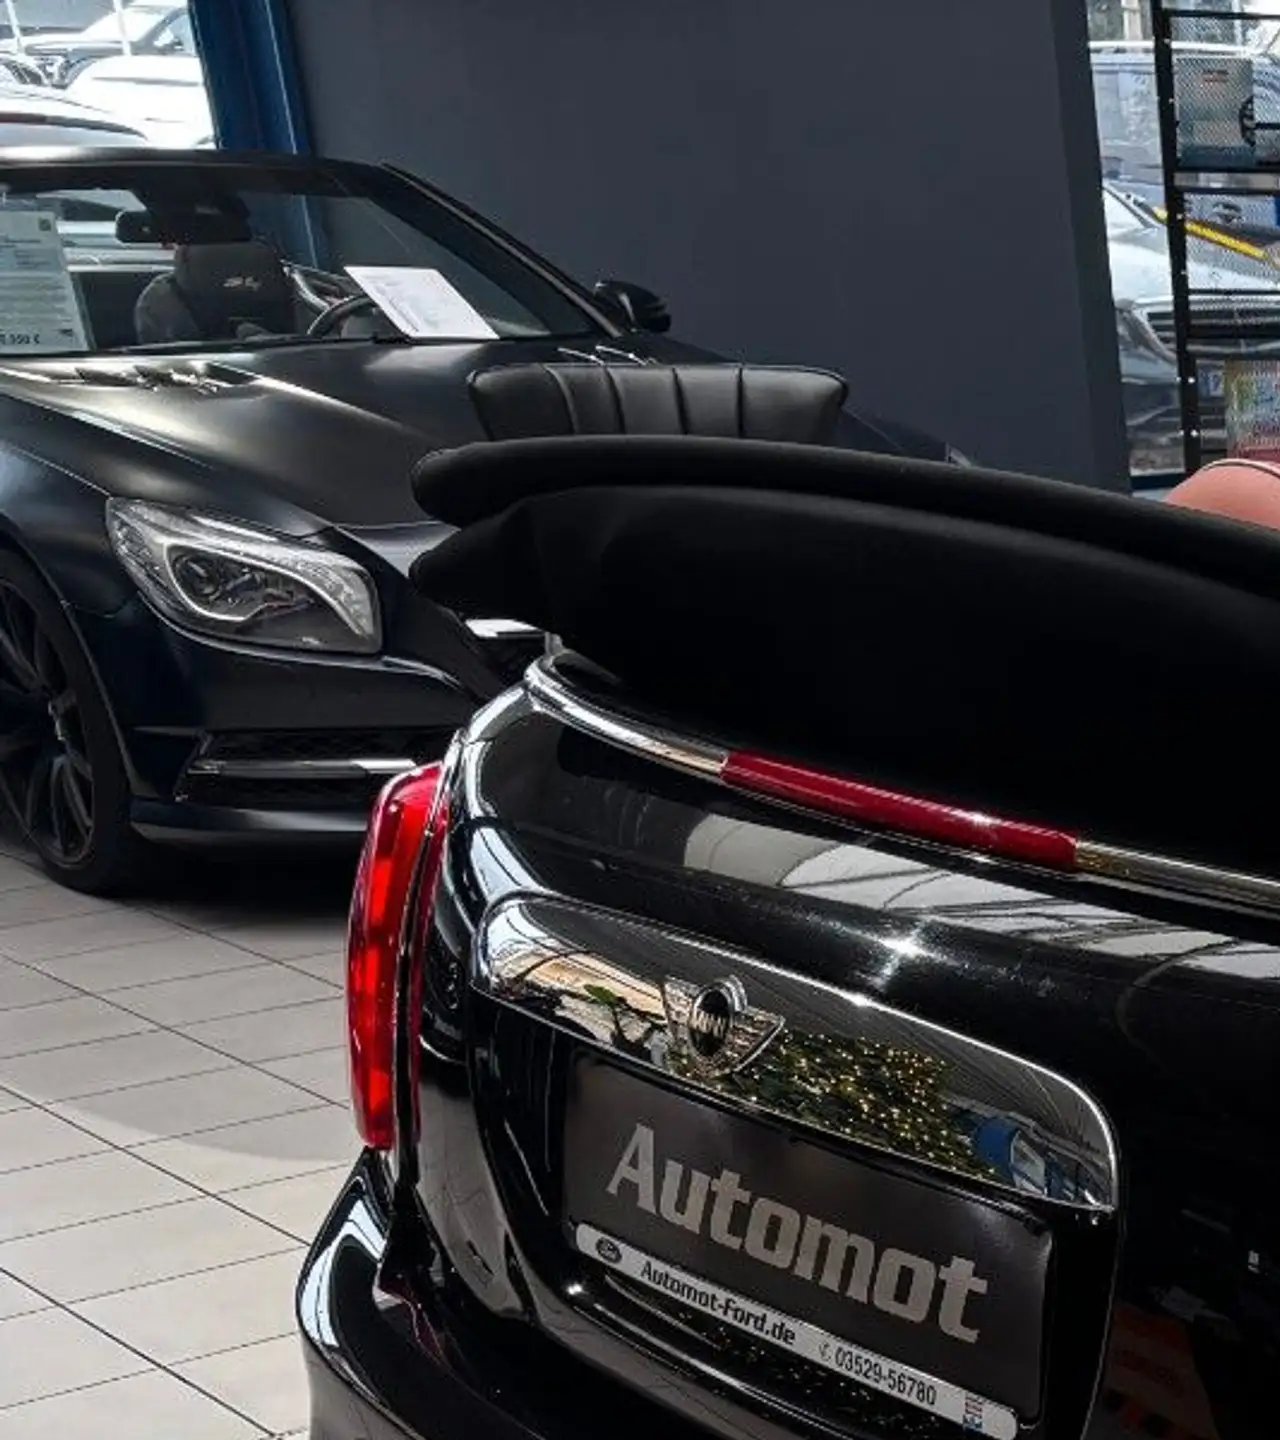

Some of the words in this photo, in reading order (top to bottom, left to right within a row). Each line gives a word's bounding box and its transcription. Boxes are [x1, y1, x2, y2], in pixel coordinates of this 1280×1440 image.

[606, 1122, 989, 1344] Automot
[640, 1260, 797, 1346] Automot-Ford.de
[835, 1346, 938, 1406] 03529-56780
